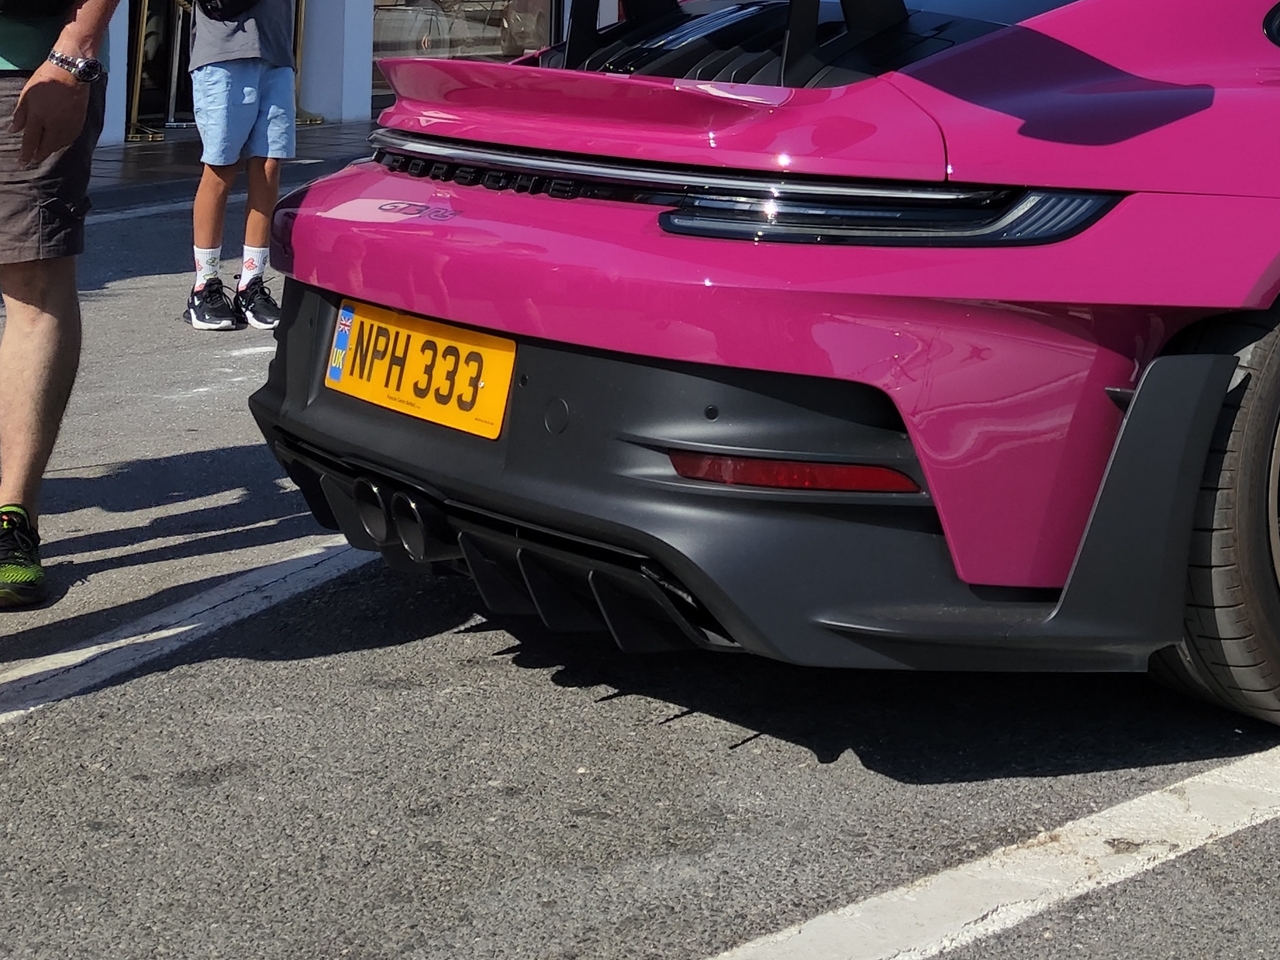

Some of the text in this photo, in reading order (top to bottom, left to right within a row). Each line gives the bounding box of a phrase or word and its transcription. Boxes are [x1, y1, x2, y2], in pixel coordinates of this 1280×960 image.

[388, 156, 577, 199] PORSCHE
[331, 347, 345, 369] UK
[349, 320, 484, 412] NPH 333
